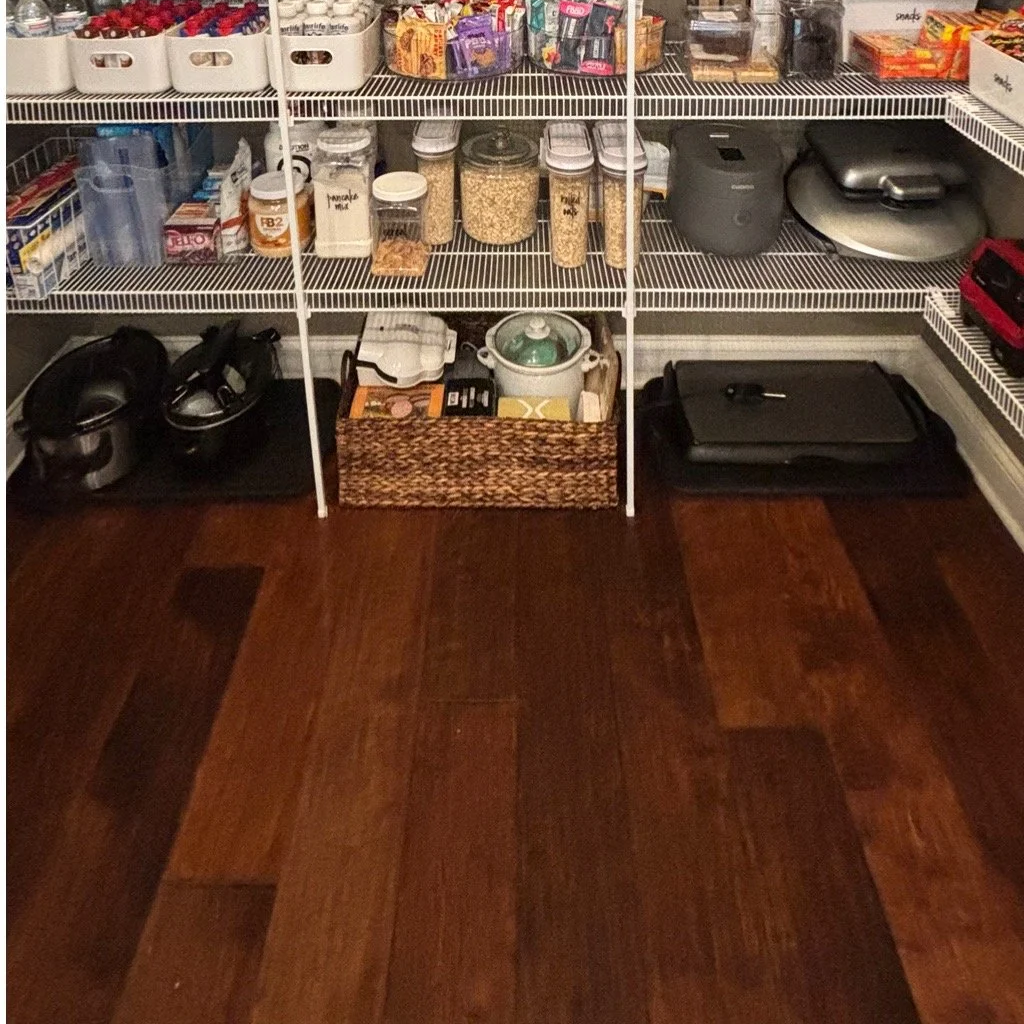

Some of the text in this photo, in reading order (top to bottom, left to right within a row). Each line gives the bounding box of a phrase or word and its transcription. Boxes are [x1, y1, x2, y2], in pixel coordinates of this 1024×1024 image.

[896, 7, 921, 22] snacks
[327, 189, 359, 209] pancake
[334, 202, 349, 211] mix
[260, 217, 284, 228] PB2
